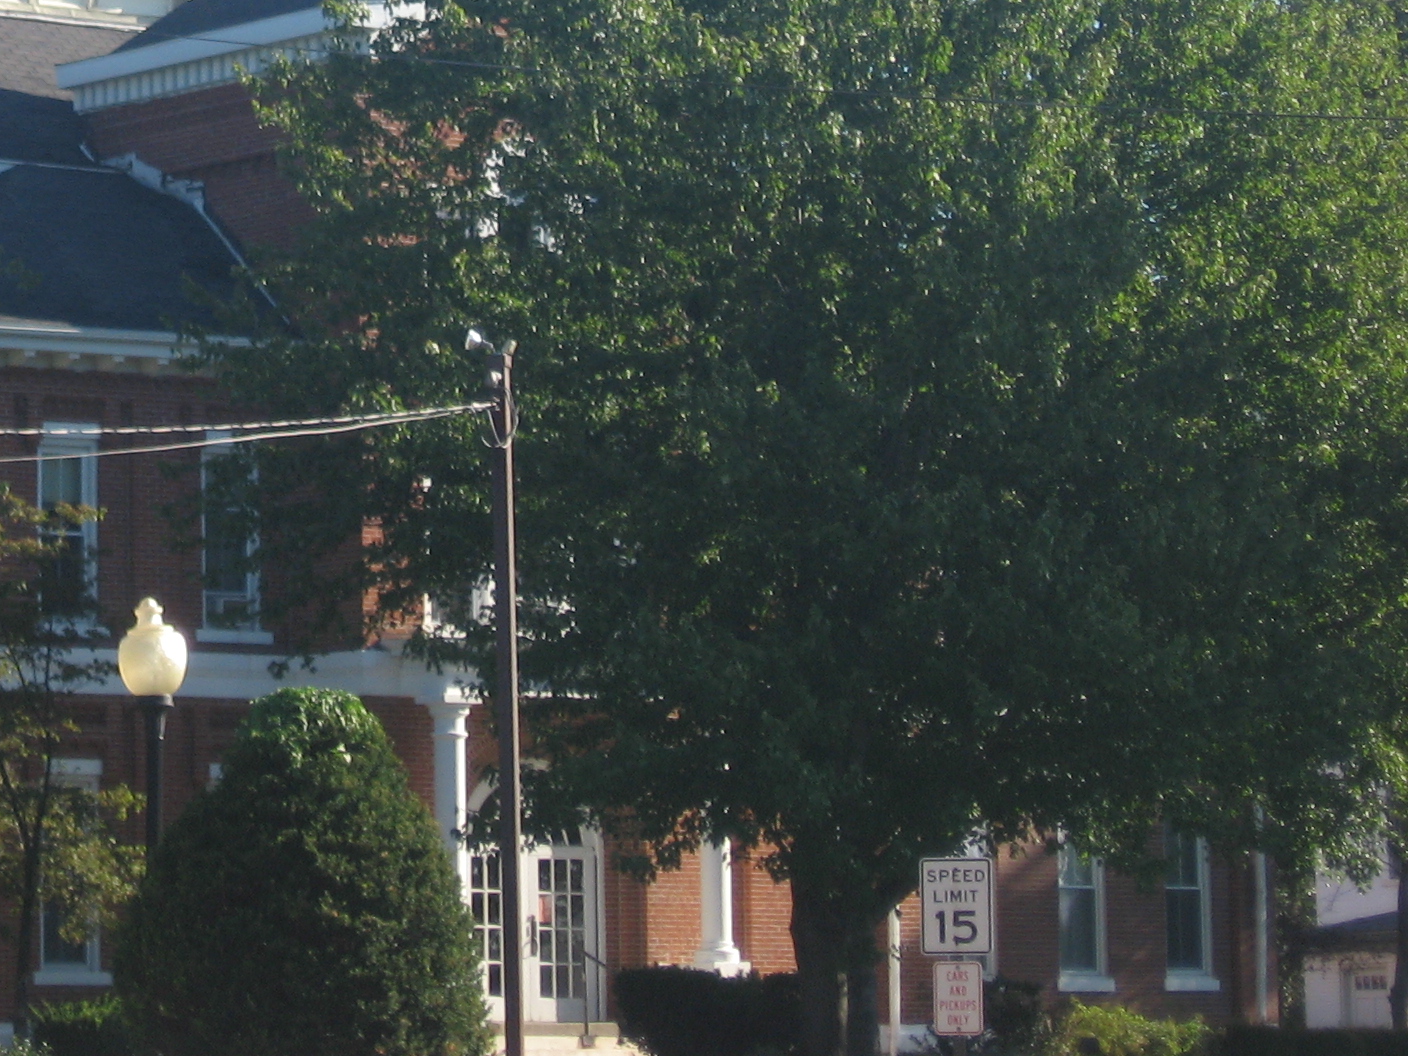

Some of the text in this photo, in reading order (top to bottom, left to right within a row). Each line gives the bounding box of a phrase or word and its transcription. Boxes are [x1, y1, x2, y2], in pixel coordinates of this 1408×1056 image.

[927, 869, 985, 883] SPEED
[933, 890, 978, 903] LIMIT
[935, 910, 977, 944] 15
[946, 970, 968, 982] CARS
[949, 986, 967, 996] AND
[939, 999, 977, 1011] PICKUPS
[947, 1014, 970, 1026] ONLY
